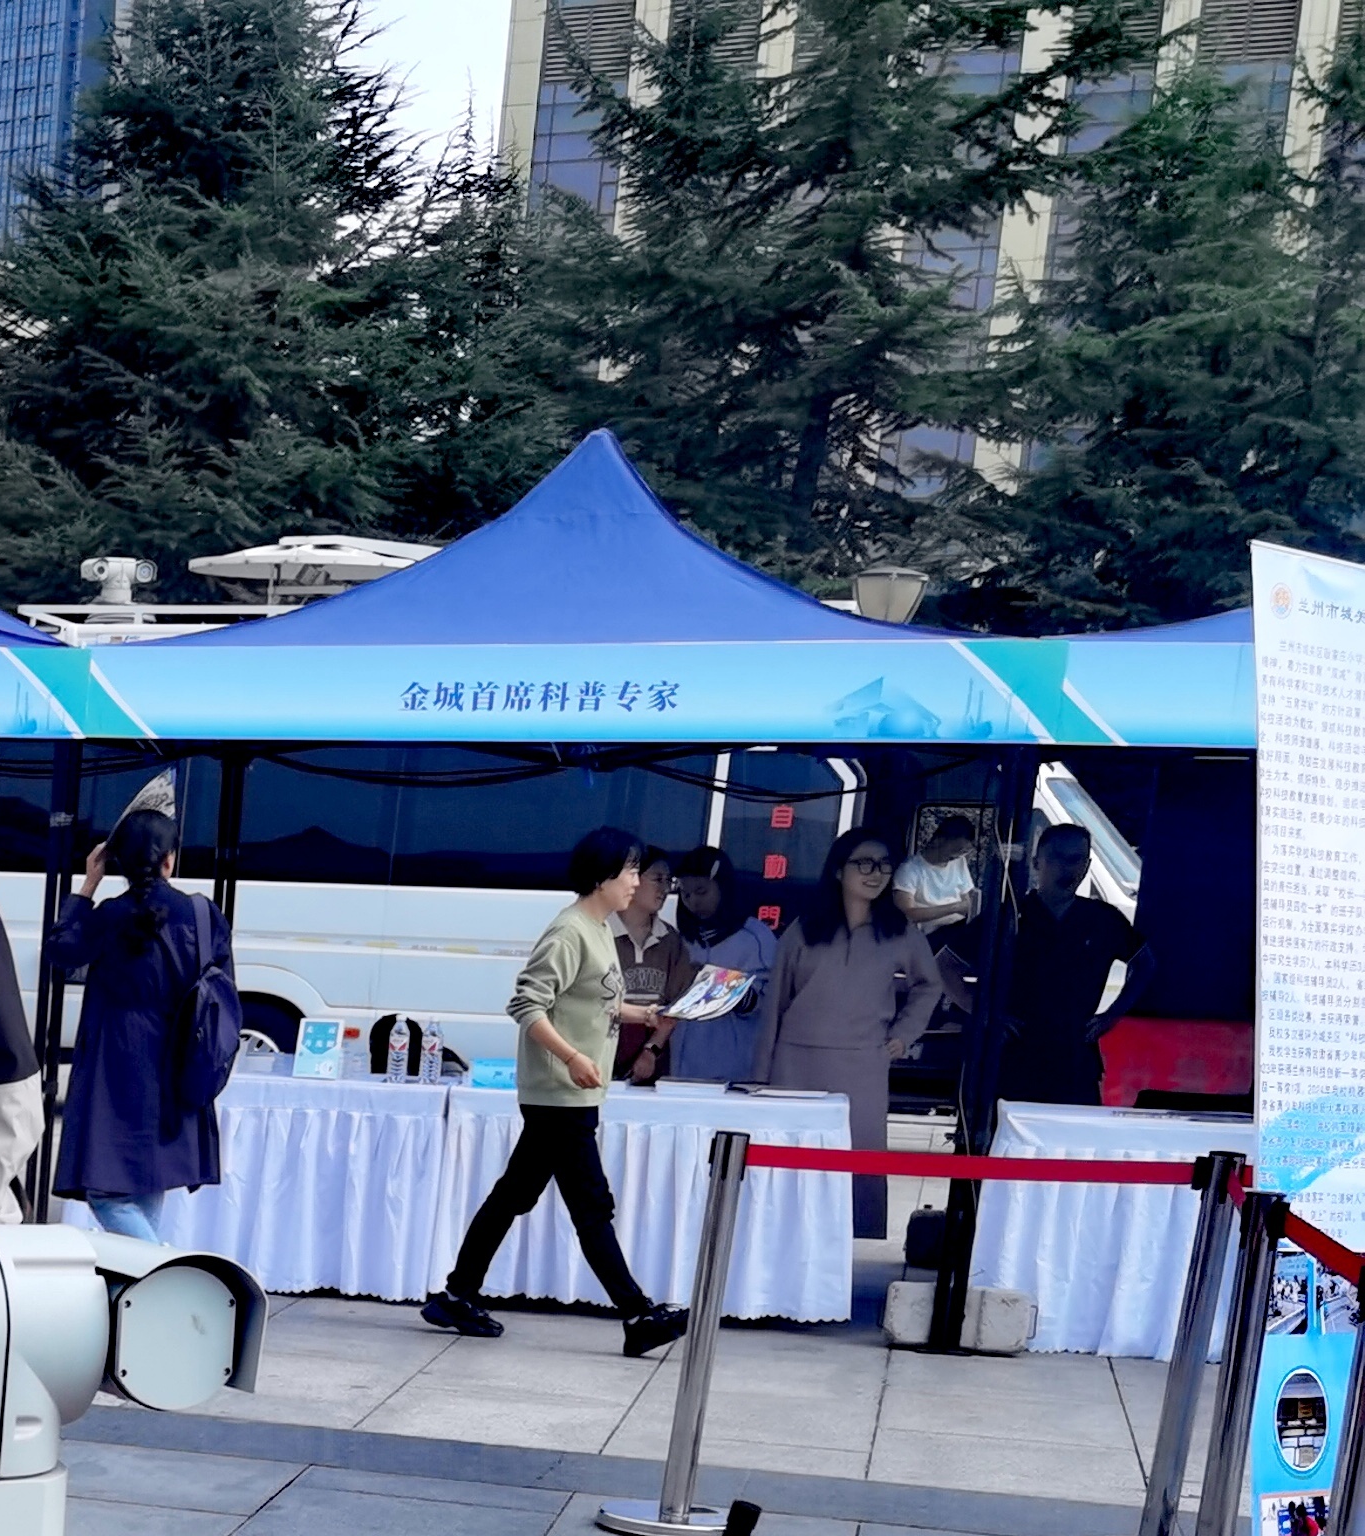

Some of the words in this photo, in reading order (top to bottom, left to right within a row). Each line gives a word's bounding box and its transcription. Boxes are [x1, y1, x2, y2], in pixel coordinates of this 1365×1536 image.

[400, 680, 680, 713] 金城首席科普专家
